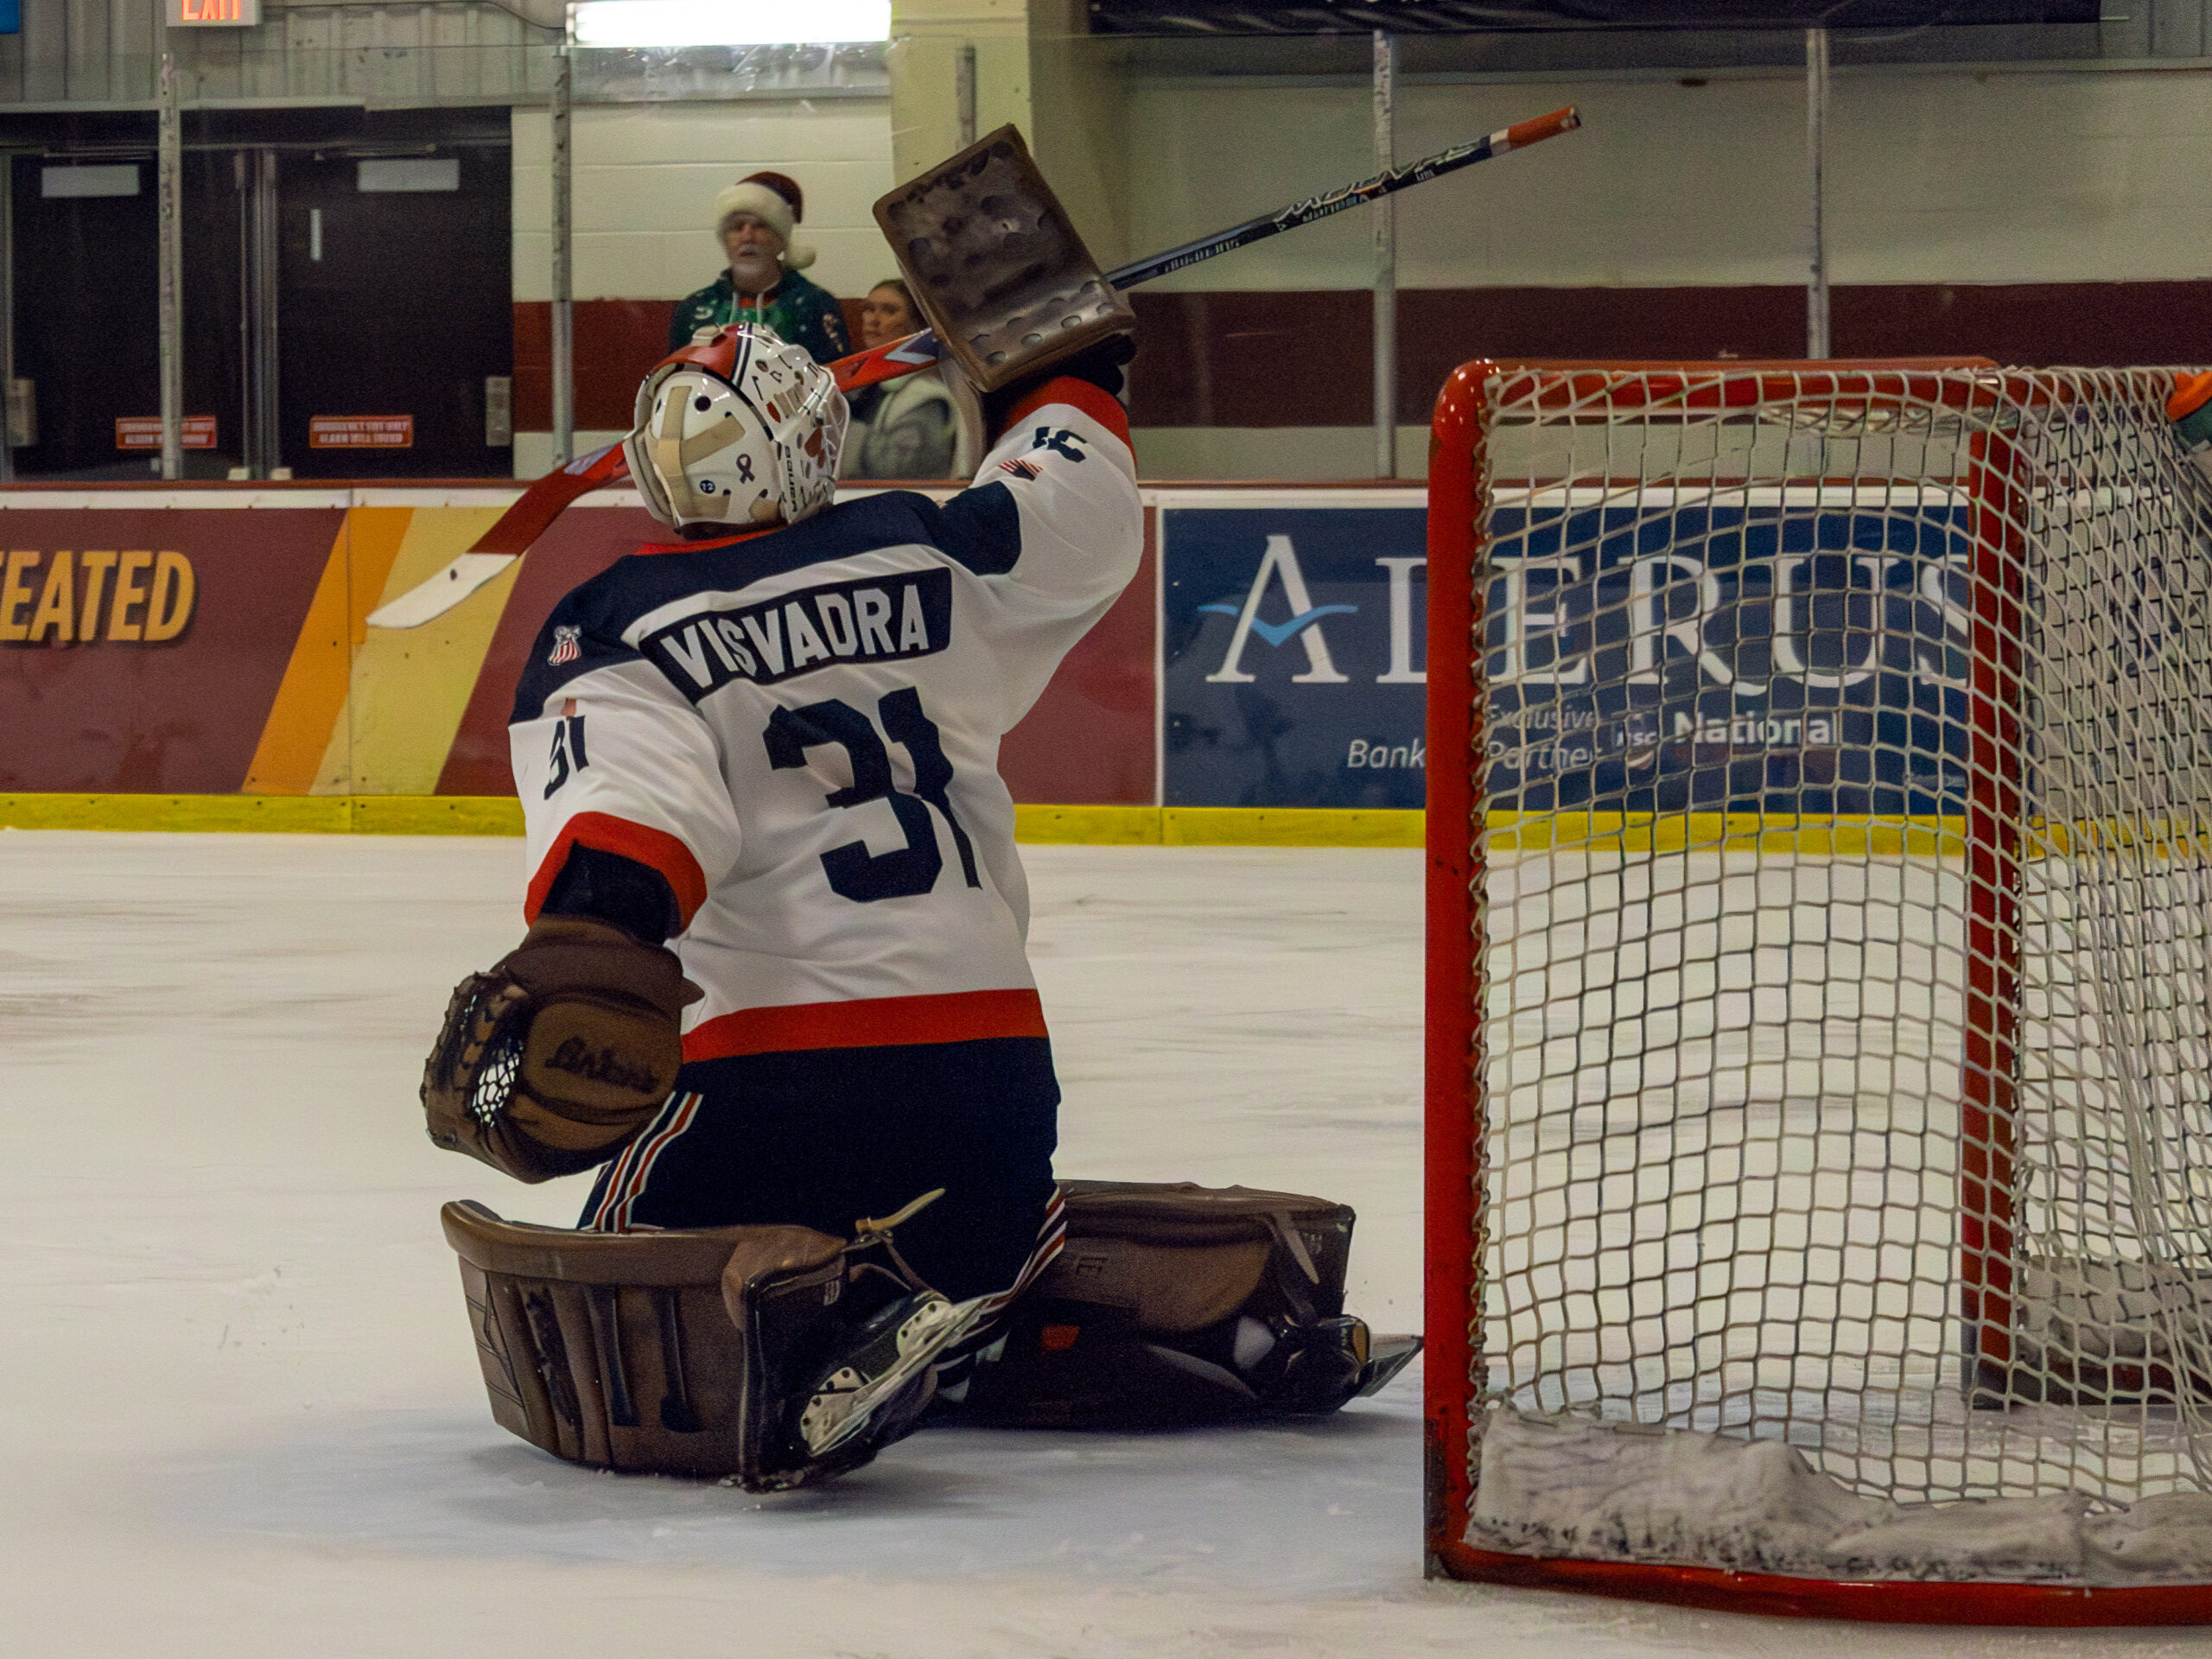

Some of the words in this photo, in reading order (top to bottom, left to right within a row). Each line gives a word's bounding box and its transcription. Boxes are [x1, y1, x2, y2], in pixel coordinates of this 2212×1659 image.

[0, 550, 195, 641] EATED
[659, 584, 929, 689] VISVADRA
[543, 715, 589, 800] 31
[1347, 738, 1426, 768] Bank
[1674, 710, 1839, 745] National
[762, 685, 982, 904] 31
